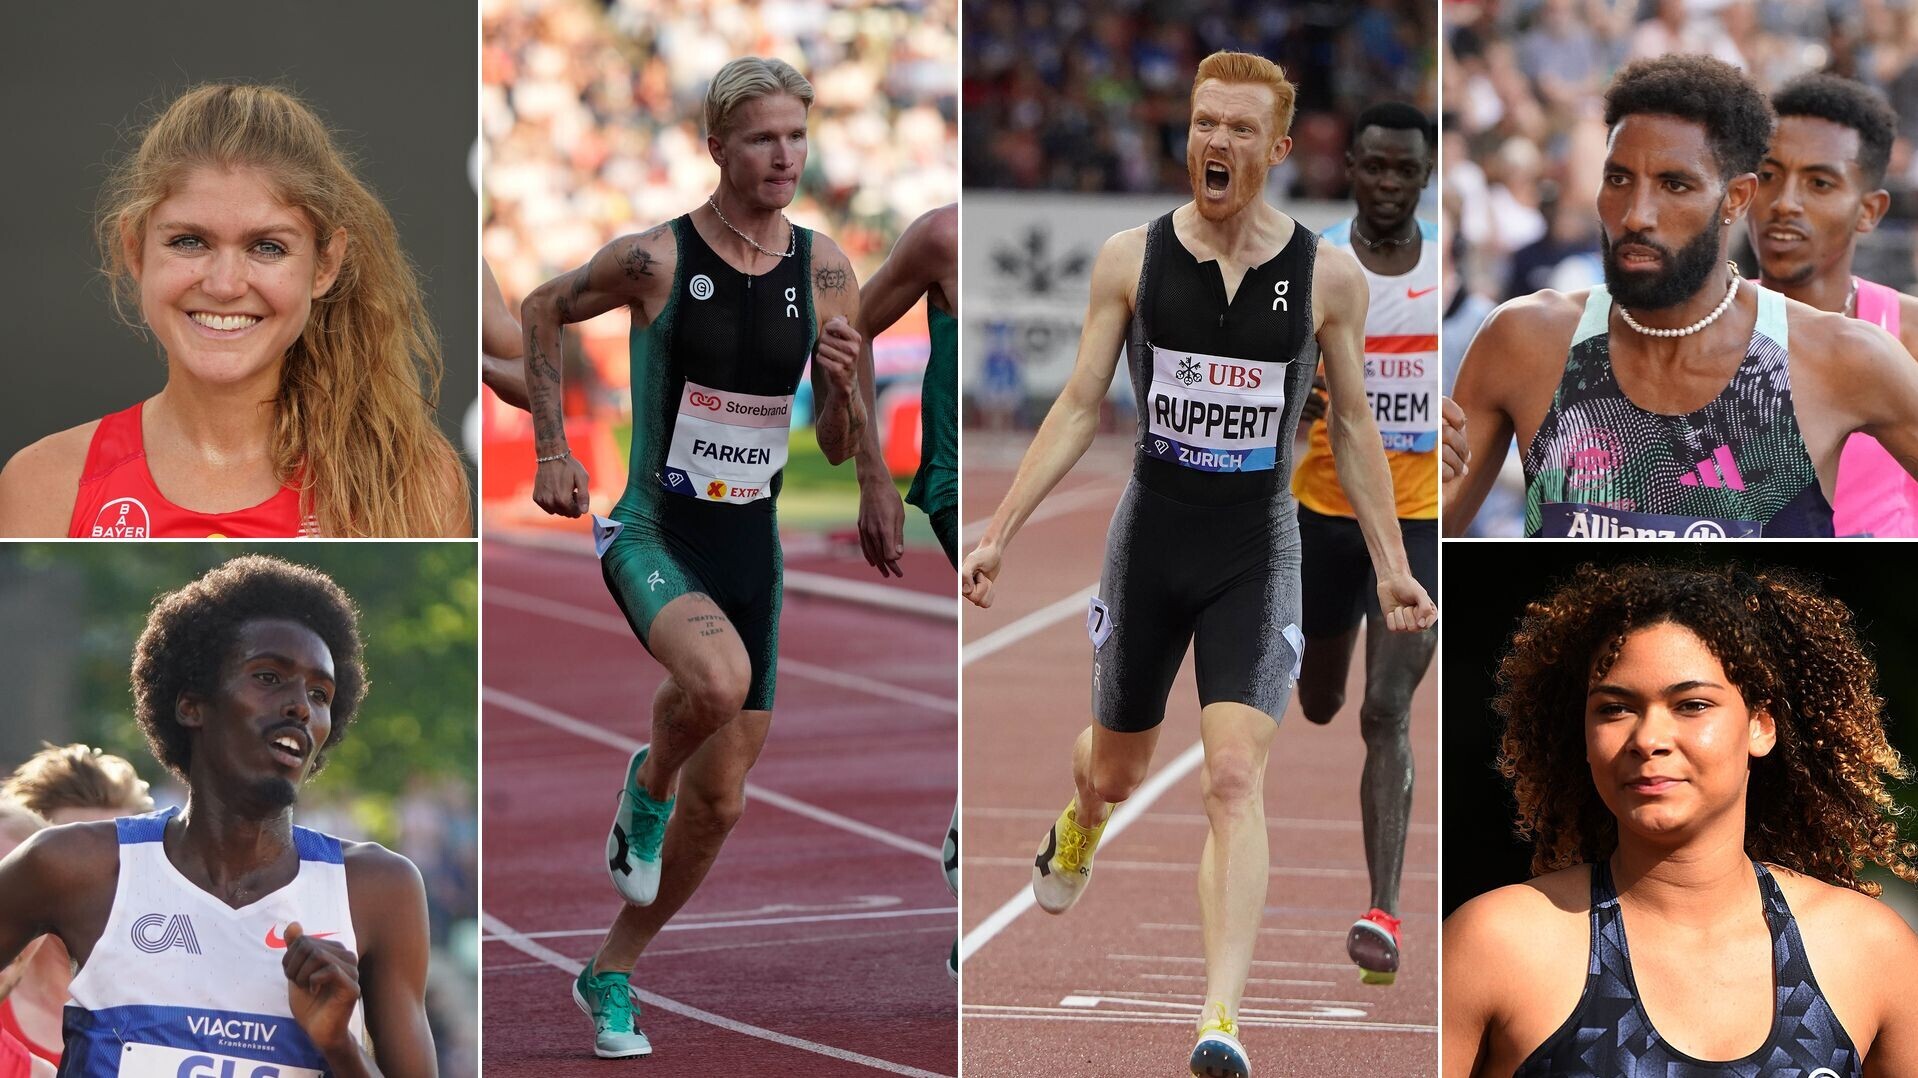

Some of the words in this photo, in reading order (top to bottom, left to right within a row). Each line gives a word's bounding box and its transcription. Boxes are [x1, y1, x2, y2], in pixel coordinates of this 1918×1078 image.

[1208, 362, 1262, 389] UBS
[1379, 358, 1424, 379] UBS
[725, 401, 788, 417] Storebrand
[1154, 393, 1278, 440] RUPPERT
[692, 438, 770, 465] FARKEN
[1178, 447, 1243, 468] ZURICH
[730, 487, 761, 499] EXTR
[92, 525, 145, 538] BAYER
[1094, 605, 1105, 633] 7
[187, 1015, 278, 1042] VIACTIV
[218, 1038, 276, 1052] Krankenkasse
